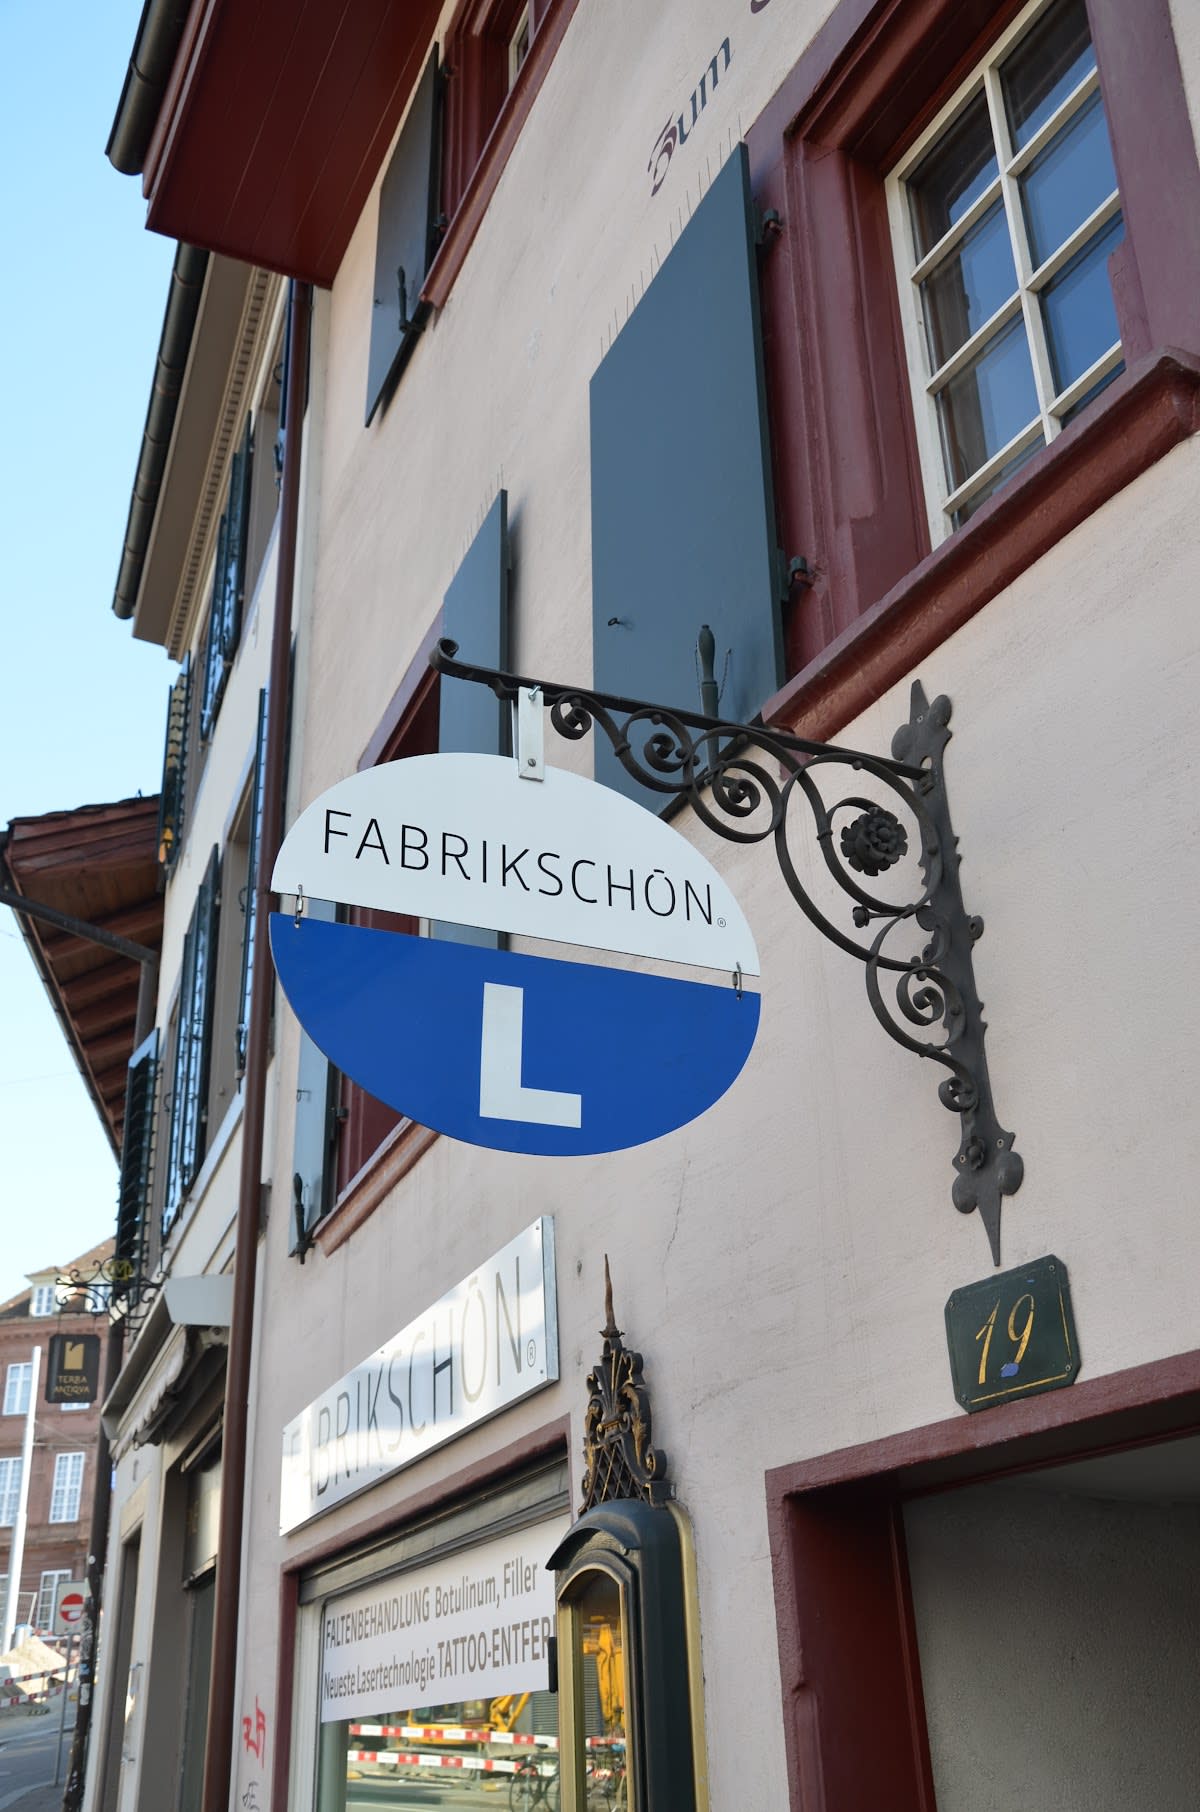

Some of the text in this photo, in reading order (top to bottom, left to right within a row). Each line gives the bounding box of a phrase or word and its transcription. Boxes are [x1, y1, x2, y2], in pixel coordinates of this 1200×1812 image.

[479, 981, 582, 1128] L
[975, 1293, 1035, 1385] 19
[324, 1556, 538, 1650] FALTENBEHANDLUNG Botulinum, Filler
[322, 1669, 356, 1701] Neueste
[356, 1647, 435, 1692] Lasertechnologie
